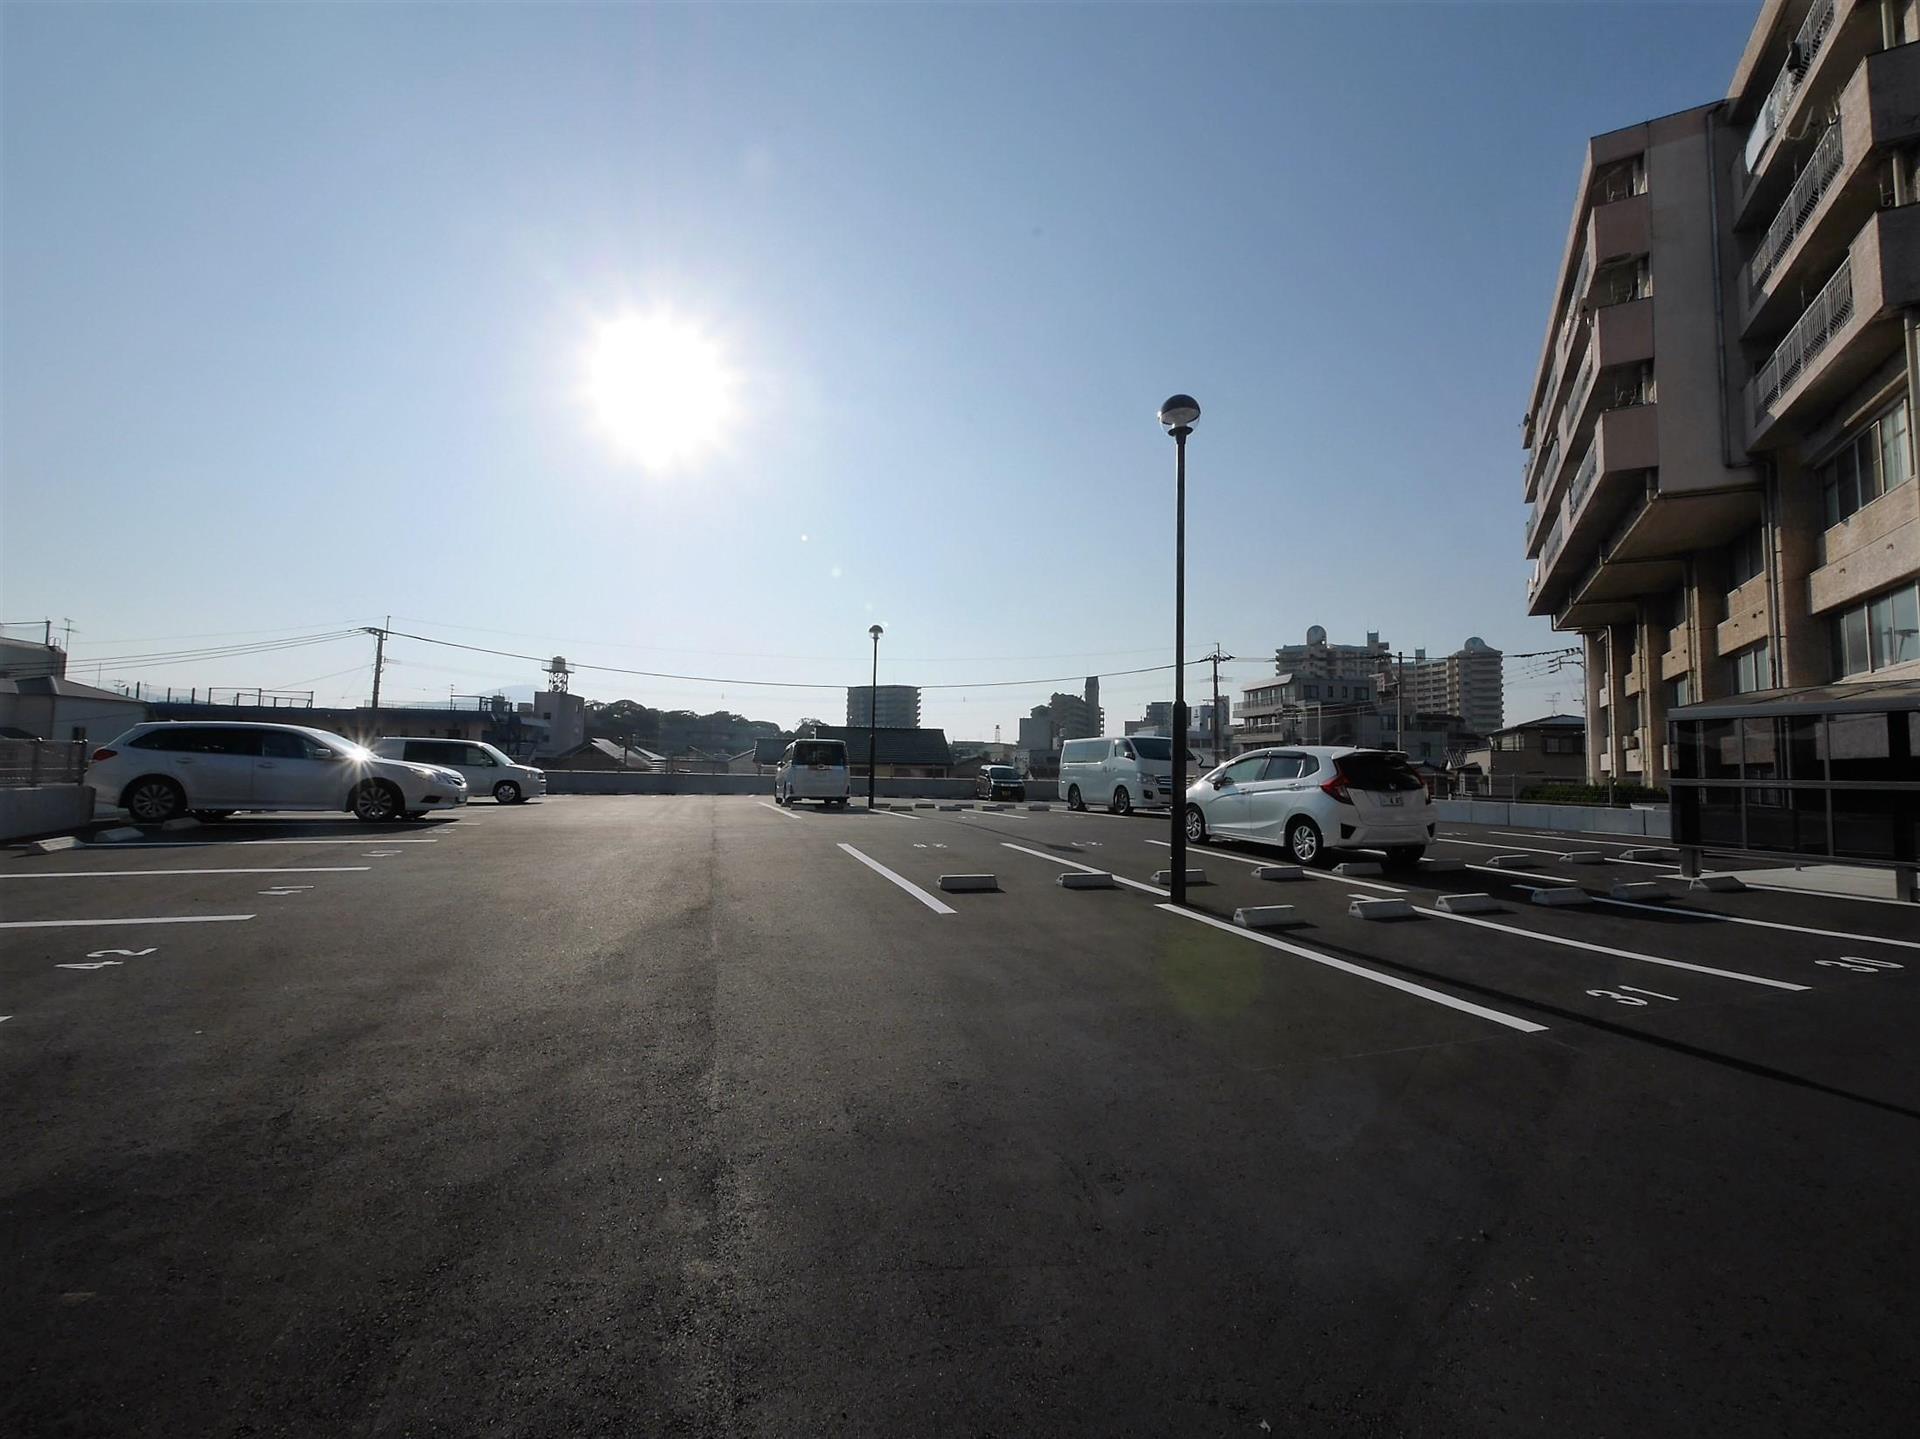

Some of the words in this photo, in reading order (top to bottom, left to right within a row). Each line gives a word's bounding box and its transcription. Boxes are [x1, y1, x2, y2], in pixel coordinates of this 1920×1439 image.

[54, 947, 159, 970] 42
[1814, 956, 1905, 973] 30
[1585, 984, 1680, 1006] 31
